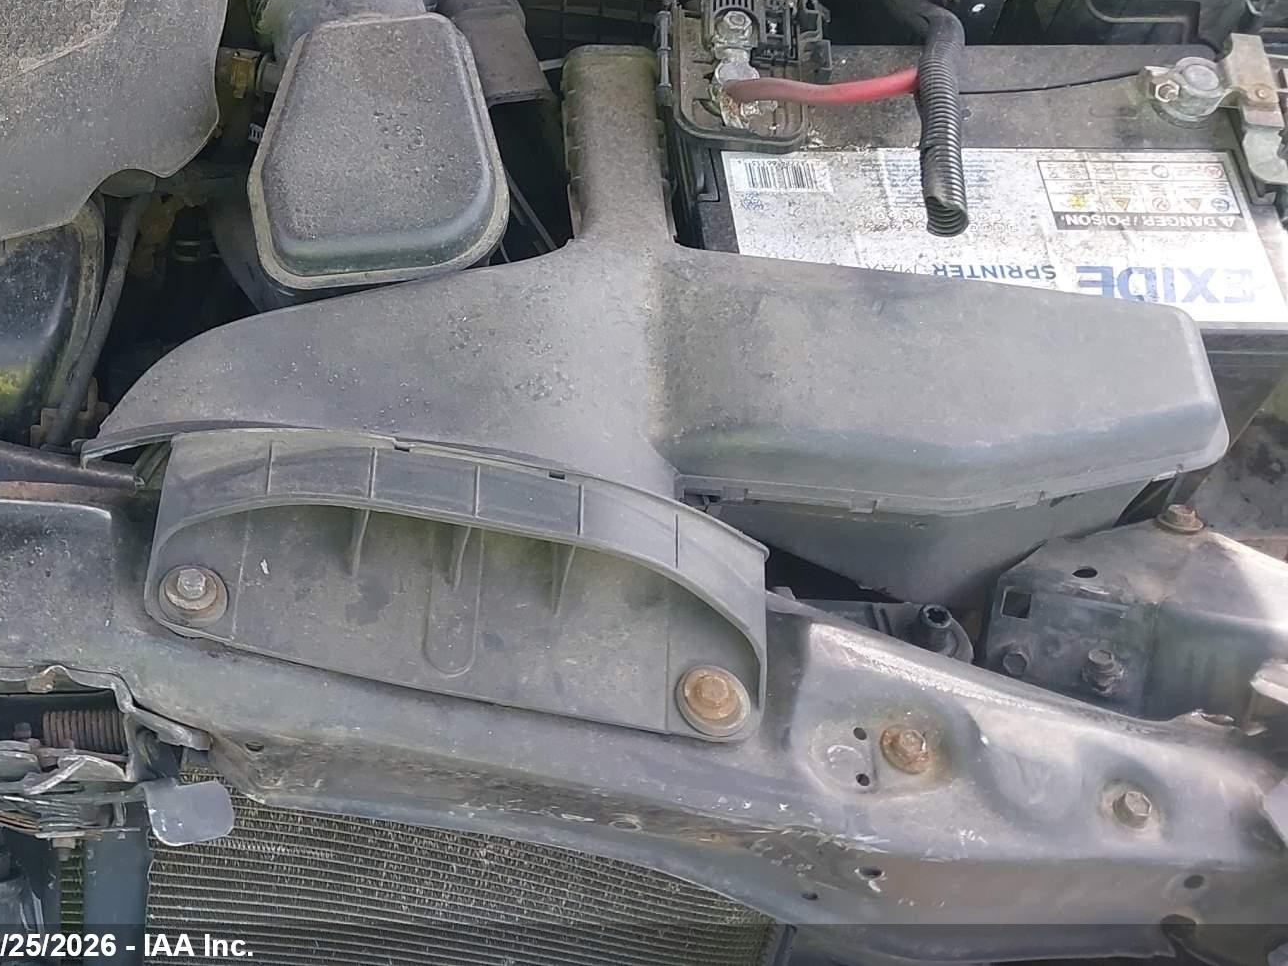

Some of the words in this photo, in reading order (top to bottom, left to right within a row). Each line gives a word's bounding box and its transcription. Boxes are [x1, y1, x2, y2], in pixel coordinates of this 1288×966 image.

[1144, 213, 1219, 229] DANGER
[932, 263, 1057, 281] SPRINTER
[1075, 265, 1256, 304] EXIDE
